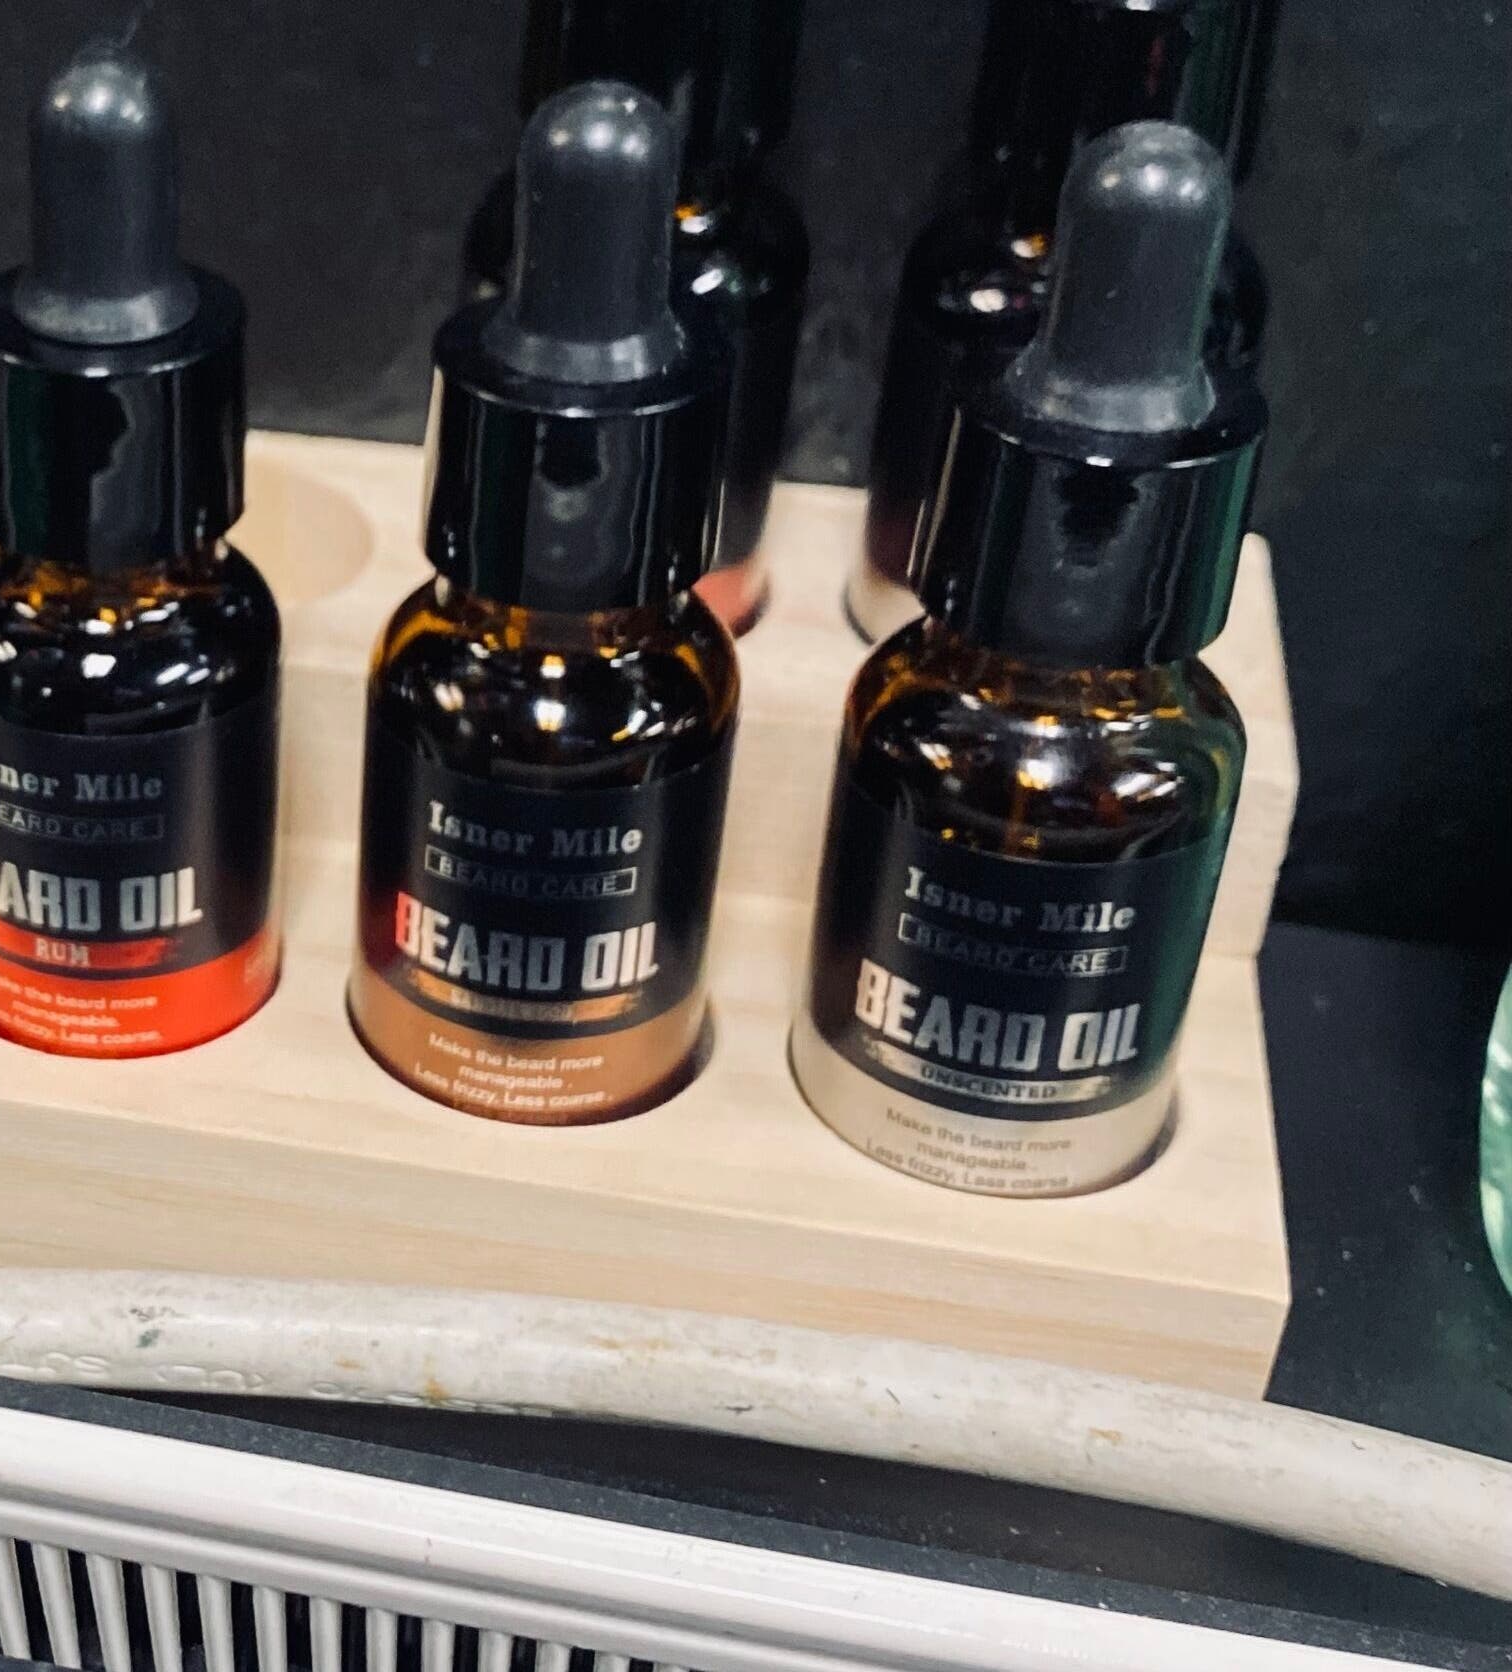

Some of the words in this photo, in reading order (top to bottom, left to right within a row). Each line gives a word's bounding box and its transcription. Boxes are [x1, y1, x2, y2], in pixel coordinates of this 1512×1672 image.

[75, 772, 164, 801] Mile
[73, 816, 146, 840] CARE
[428, 799, 535, 852] Isner
[551, 826, 643, 857] Mile
[439, 855, 529, 896] BEARD
[541, 873, 617, 896] CARE
[120, 866, 204, 932] OIL
[904, 866, 1023, 928] Isner
[1039, 901, 1137, 933] Mile
[35, 937, 90, 967] RUM
[395, 891, 566, 992] BEARD
[581, 921, 660, 992] OIL
[916, 924, 1017, 970] BEARD
[1028, 950, 1110, 975] CARE
[855, 957, 1046, 1073] BEARD
[1057, 1002, 1142, 1073] OIL
[428, 1031, 472, 1059] Make
[475, 1049, 503, 1067] the
[506, 1053, 557, 1072] beard
[560, 1054, 605, 1071] more
[503, 1090, 545, 1107] Less
[919, 1063, 1058, 1099] UNSCENTED
[887, 1107, 932, 1135] Make
[937, 1125, 965, 1145] the
[970, 1133, 1023, 1152] beard
[1027, 1138, 1073, 1152] more
[865, 1137, 905, 1166] Less
[963, 1171, 1007, 1188] Less
